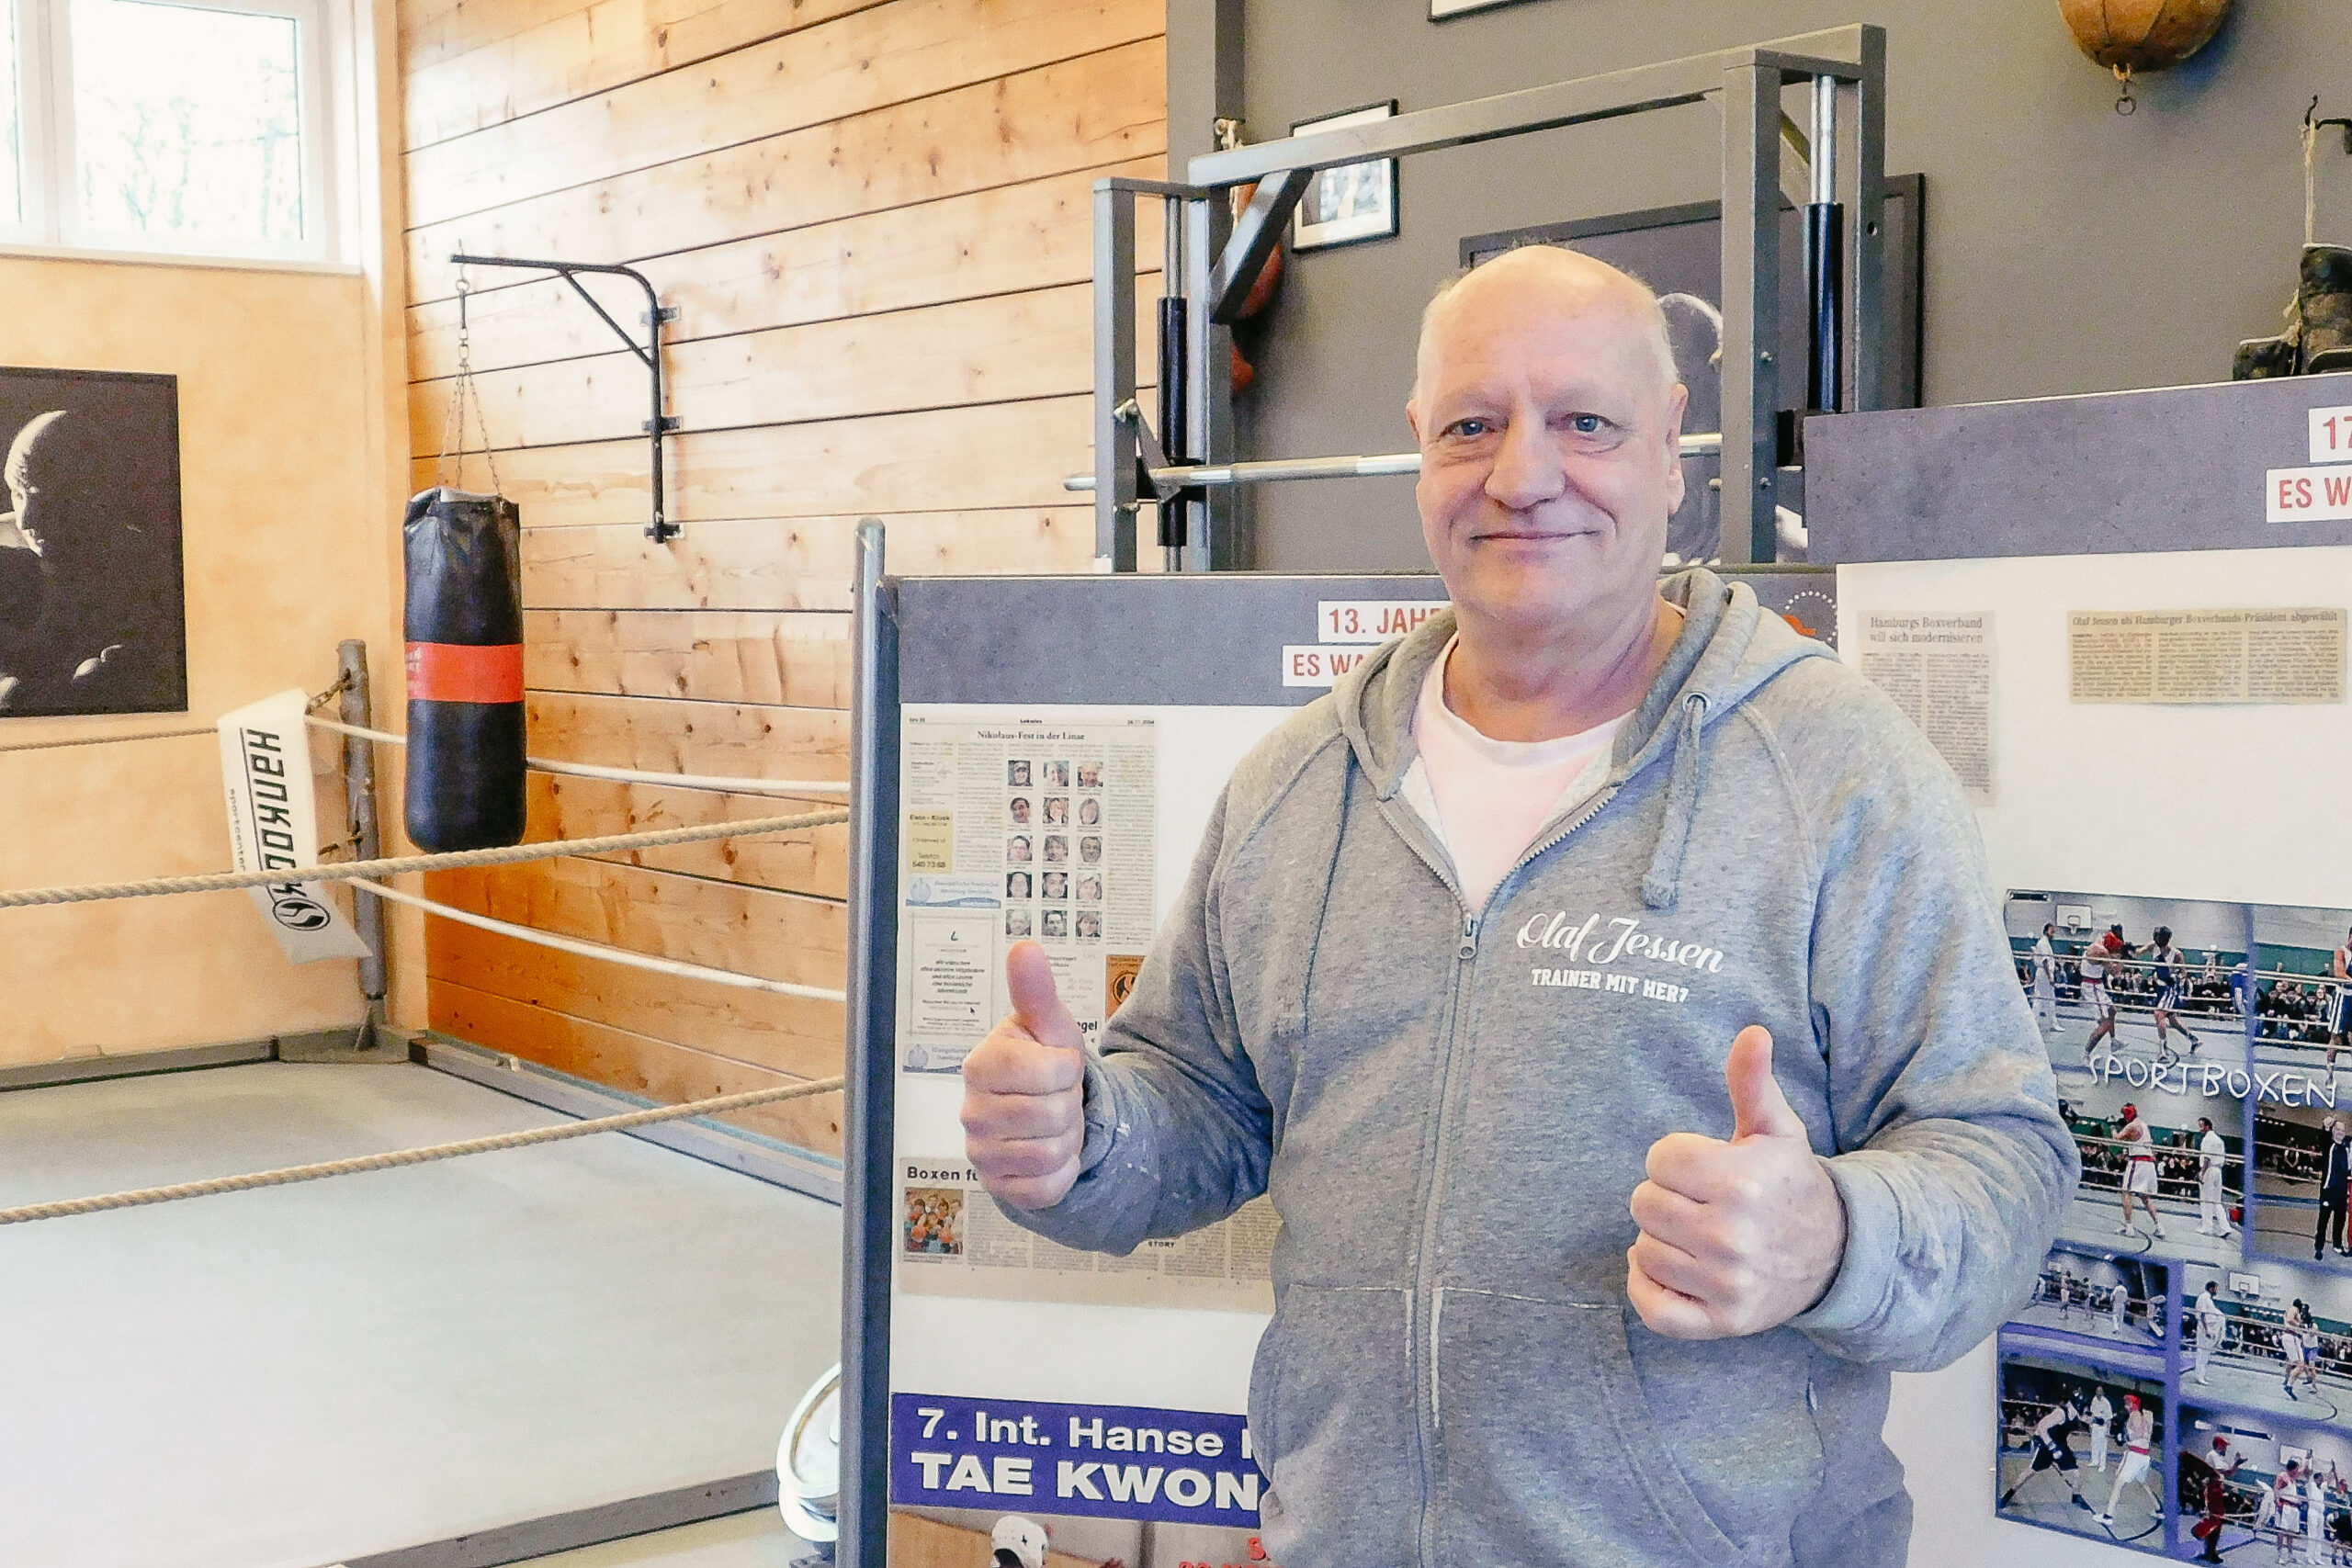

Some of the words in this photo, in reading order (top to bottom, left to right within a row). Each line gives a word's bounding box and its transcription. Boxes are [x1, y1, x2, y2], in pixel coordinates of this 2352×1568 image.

[2278, 478, 2313, 509] ES
[1329, 607, 1367, 634] 13.
[1376, 607, 1440, 634] JAH
[1871, 616, 1919, 631] Hamburgs
[1922, 616, 1984, 629] Boxverband
[1870, 631, 1887, 643] will
[1889, 631, 1909, 643] sich
[1293, 653, 1321, 677] ES
[1517, 911, 1600, 962] Olaf
[1588, 917, 1724, 973] Jessen
[1532, 969, 1601, 989] TRAINER
[1605, 974, 1639, 994] MIT
[906, 1166, 960, 1180] Boxen
[917, 1407, 958, 1440] 7.
[976, 1411, 1050, 1446] Int.
[1069, 1416, 1224, 1457] Hanse
[910, 1452, 1033, 1495] TAE
[1057, 1461, 1259, 1511] KWON
